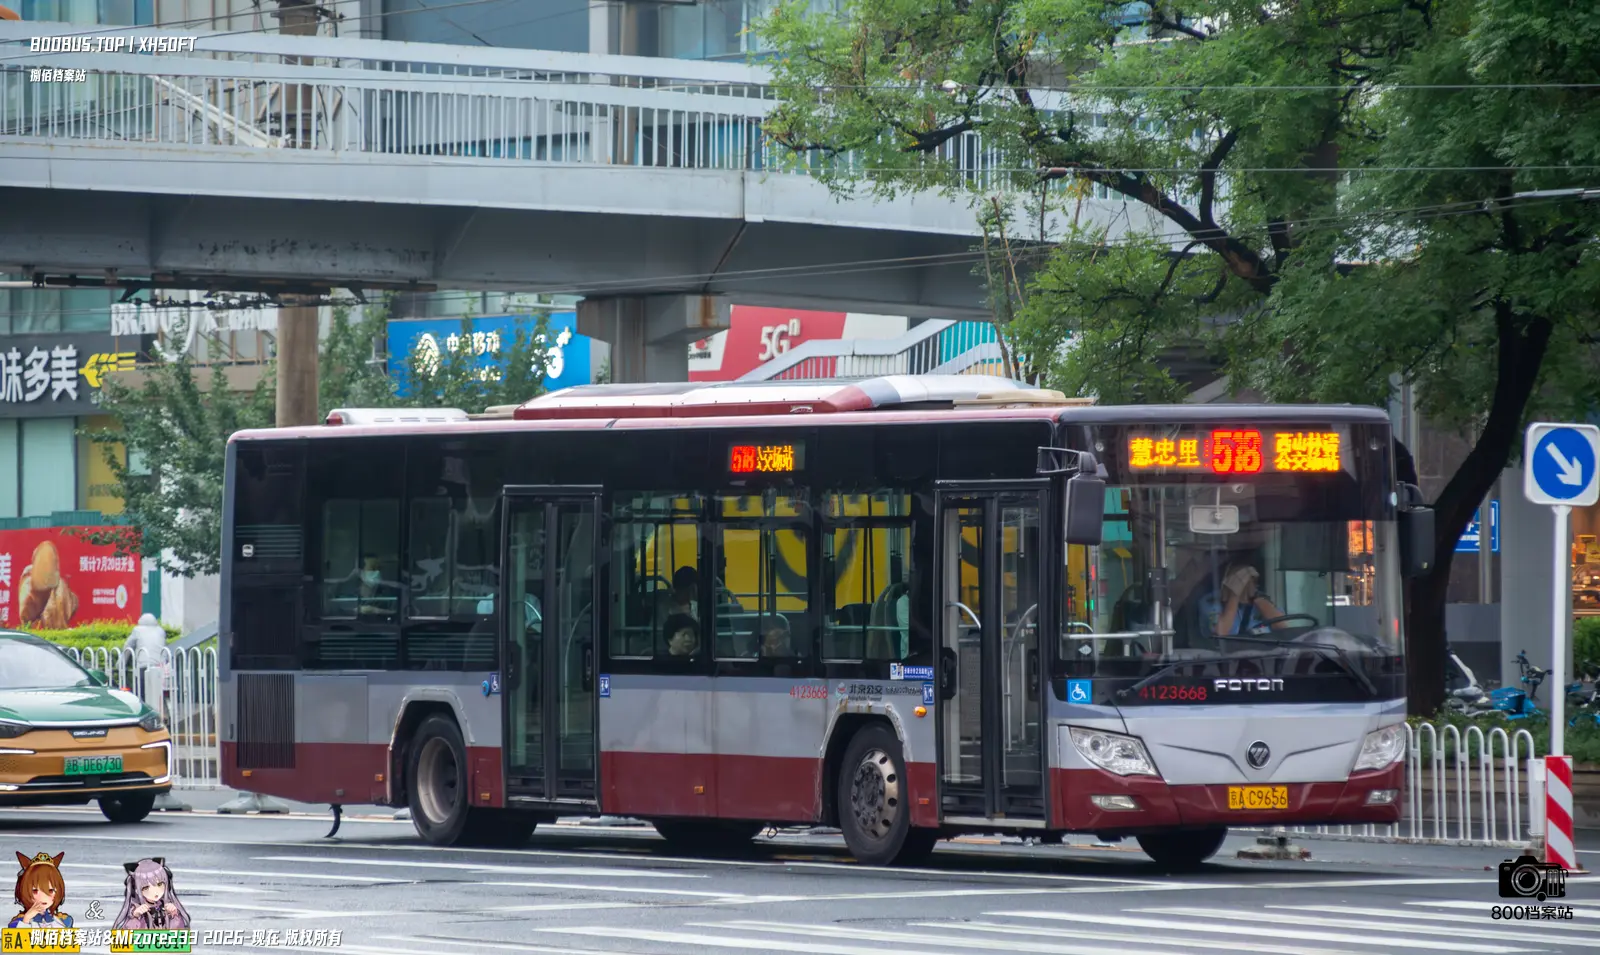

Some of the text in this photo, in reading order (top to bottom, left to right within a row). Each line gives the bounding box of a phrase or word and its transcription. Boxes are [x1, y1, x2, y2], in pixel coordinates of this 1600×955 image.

[0, 345, 77, 402] 味多美
[1130, 430, 1262, 473] 慧忠里 518
[790, 685, 829, 700] 4123668
[849, 684, 883, 694] 北京公交
[1140, 678, 1284, 700] 4123668 FOTON
